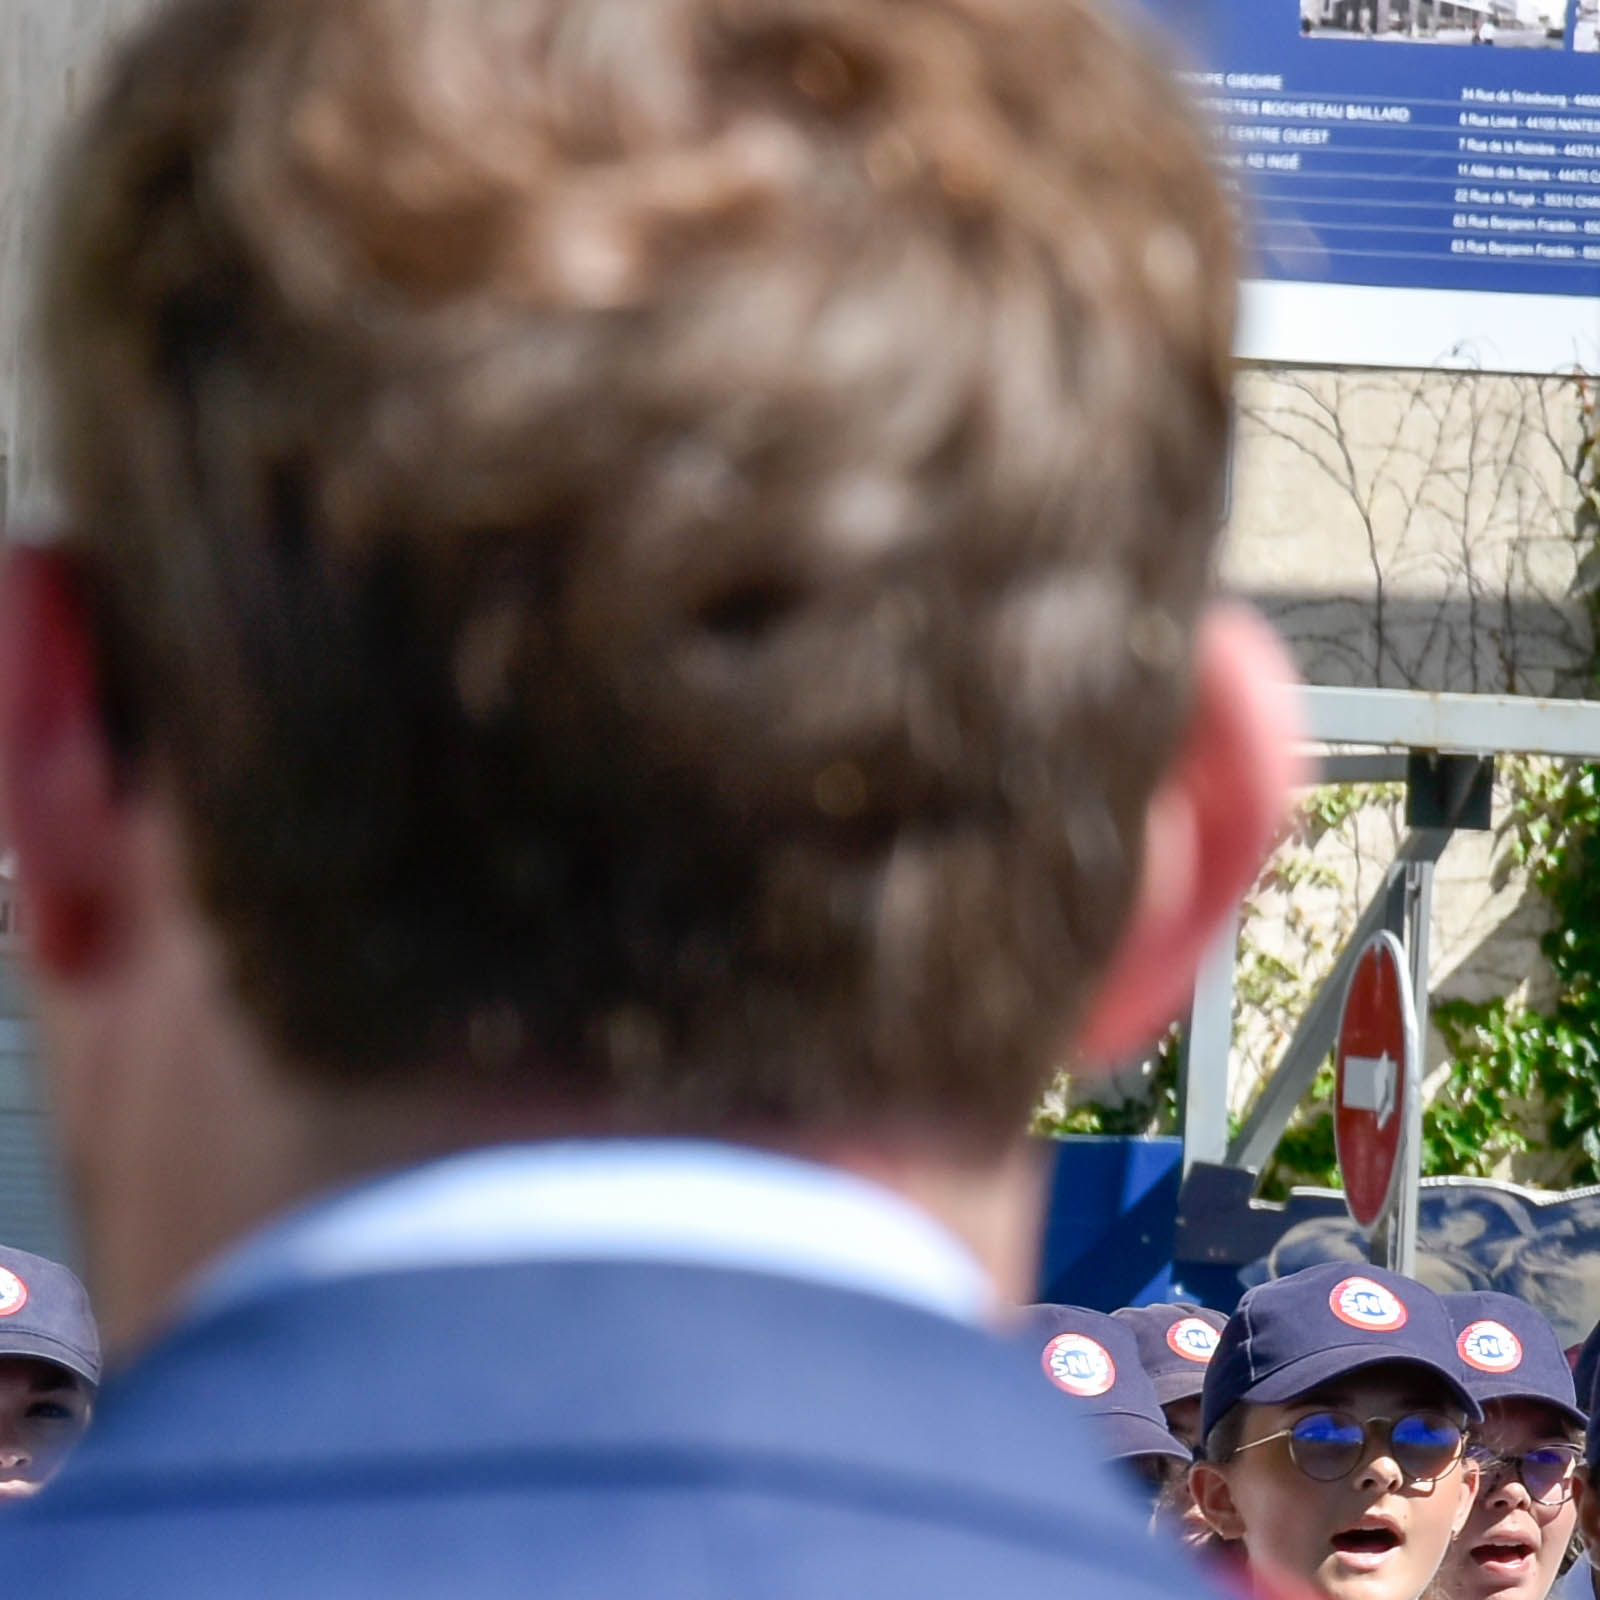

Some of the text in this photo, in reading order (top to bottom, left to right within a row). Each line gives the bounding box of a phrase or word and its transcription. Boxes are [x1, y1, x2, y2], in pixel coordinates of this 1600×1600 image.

[1475, 88, 1495, 103] Rue
[1468, 112, 1489, 128] Rue
[1467, 137, 1488, 153] Rue
[1469, 188, 1490, 204] Rue
[1468, 213, 1489, 229] Rue
[1466, 239, 1487, 255] Rue
